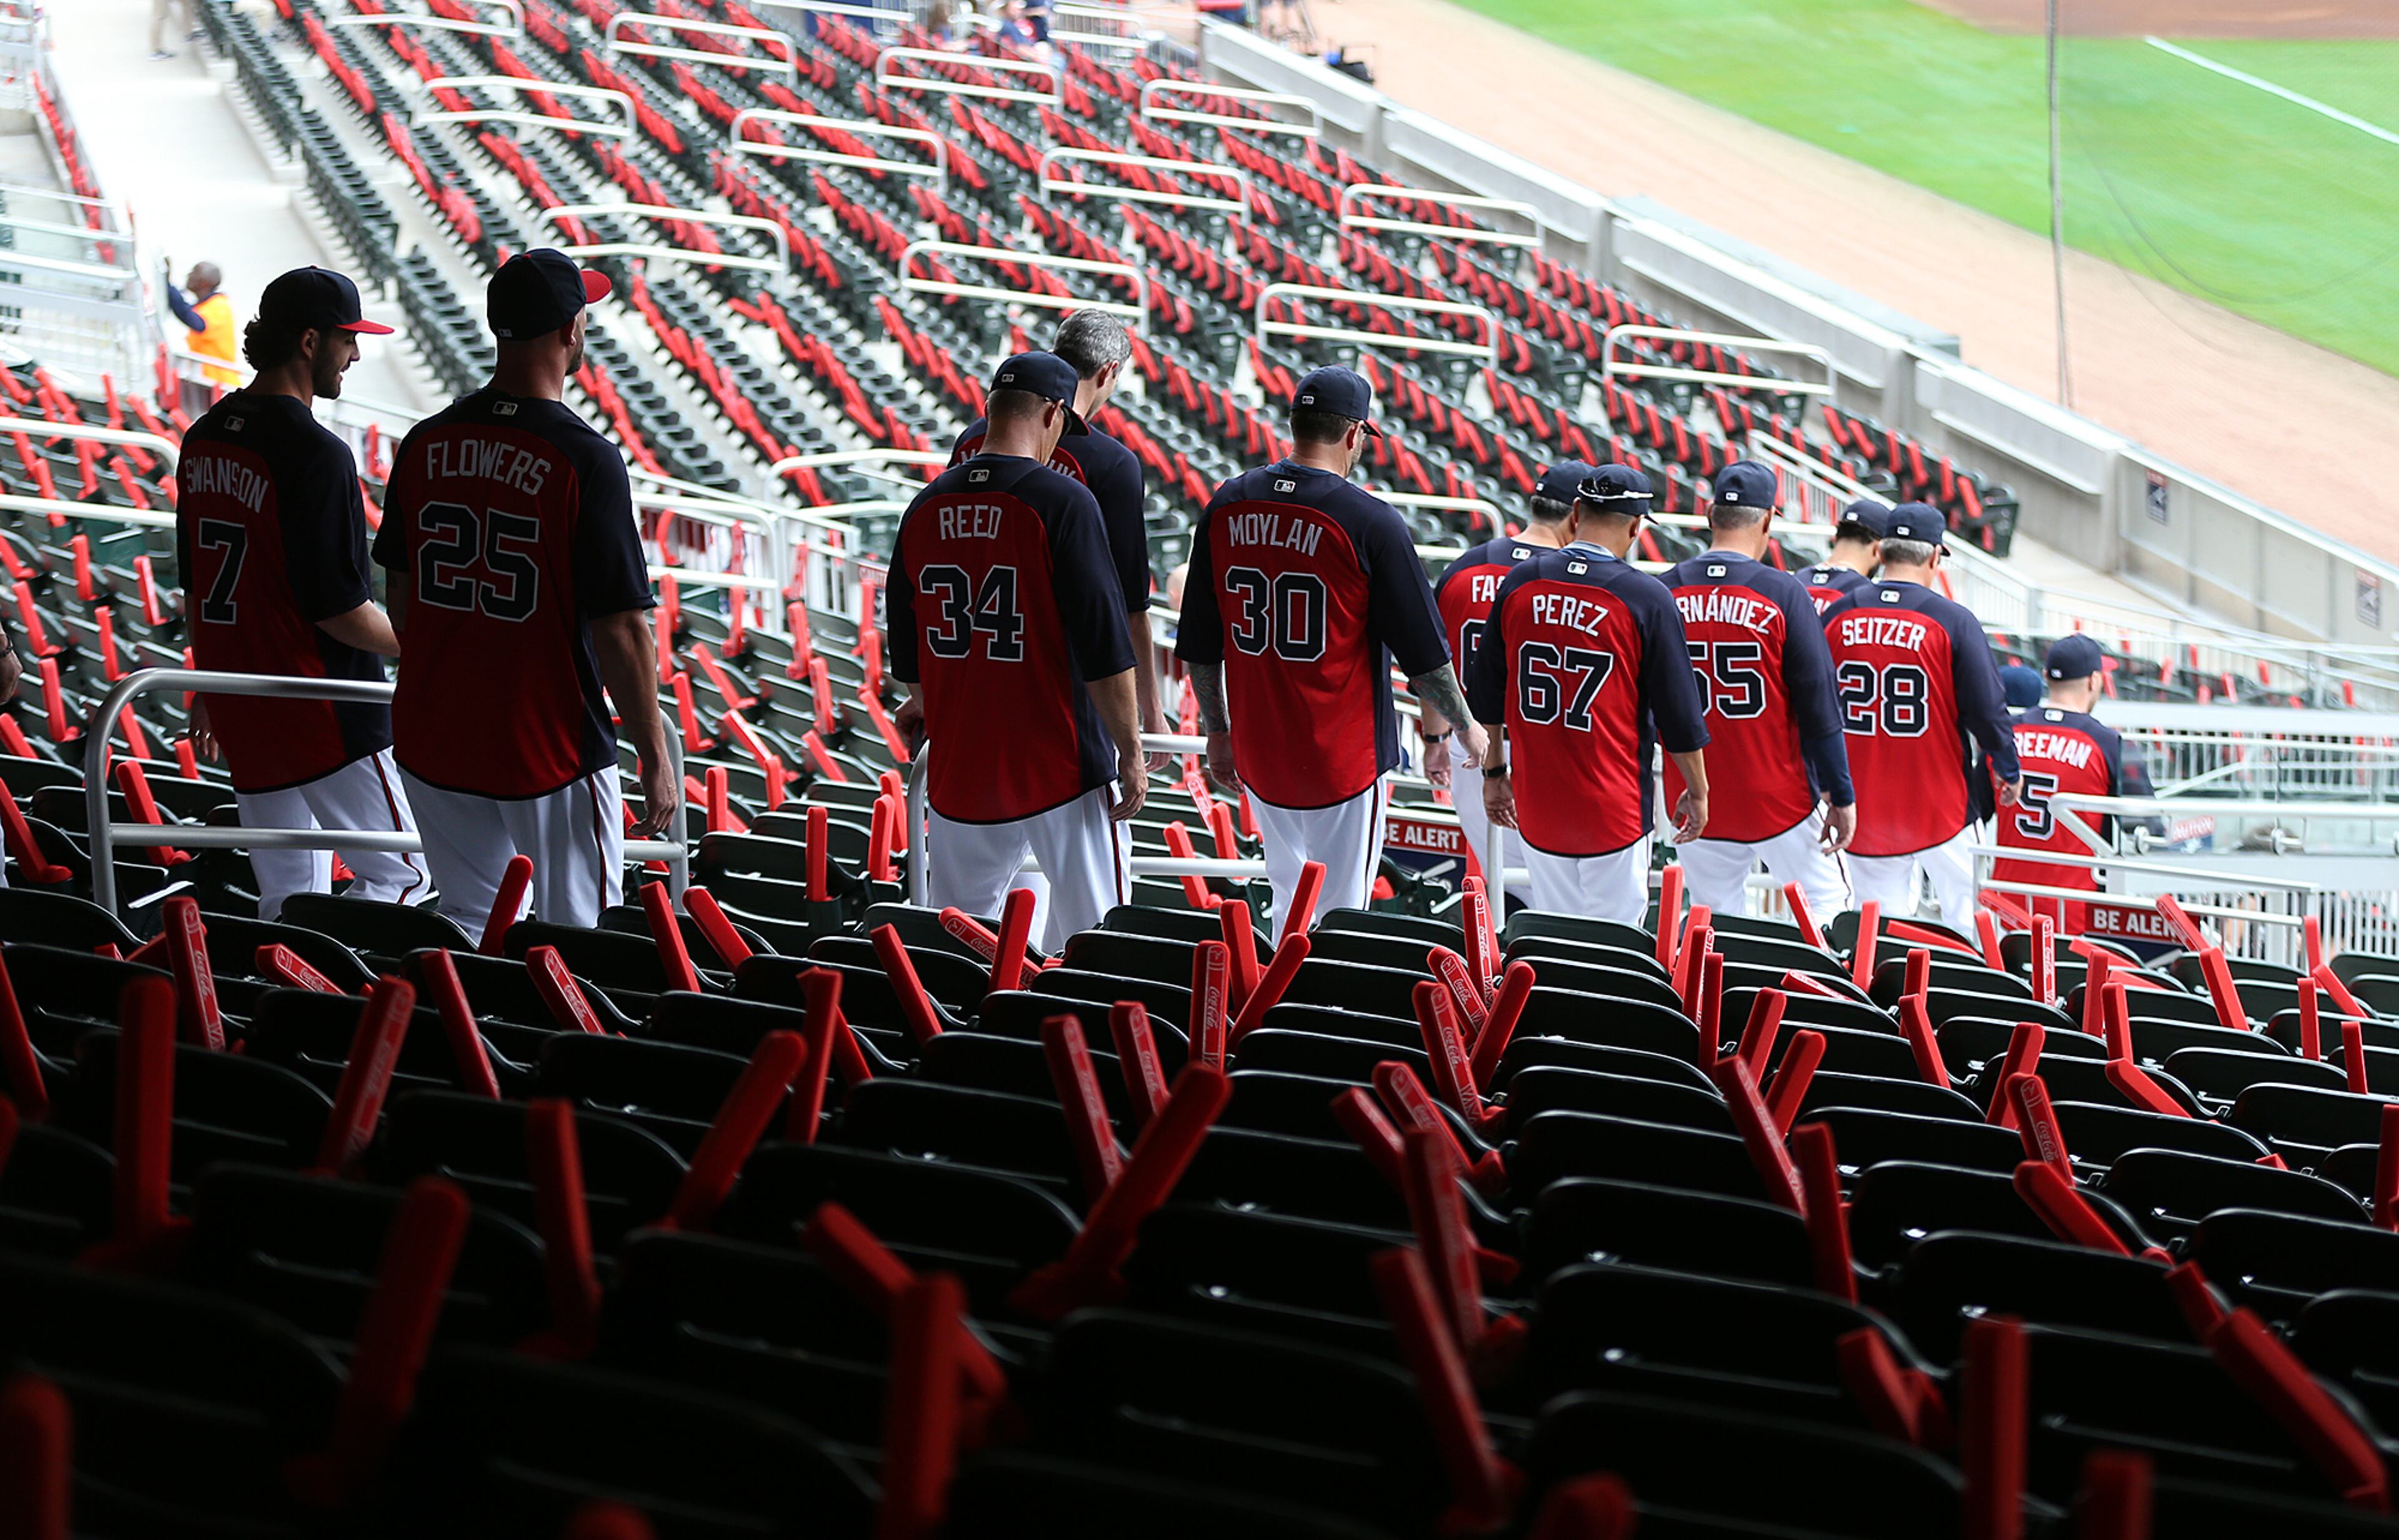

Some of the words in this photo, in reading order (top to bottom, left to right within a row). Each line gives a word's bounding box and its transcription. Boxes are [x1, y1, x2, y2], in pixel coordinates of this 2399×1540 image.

[184, 457, 269, 513] SWANSON
[426, 439, 551, 495] FLOWERS
[939, 505, 1003, 540] REED
[1228, 513, 1324, 557] MOYLAN
[198, 518, 248, 624] 7
[418, 501, 540, 623] 25
[919, 564, 1024, 662] 34
[1225, 565, 1327, 662] 30
[1532, 594, 1609, 637] PEREZ
[1676, 588, 1778, 635] RNÁNDEZ
[1841, 617, 1927, 652] SEITZER
[1517, 641, 1614, 733] 67
[1686, 640, 1766, 720] 55
[1835, 661, 1929, 738] 28
[2013, 732, 2092, 770] REEMAN
[2015, 769, 2059, 841] 5
[1404, 825, 1461, 850] ALERT
[2094, 908, 2120, 931] BE
